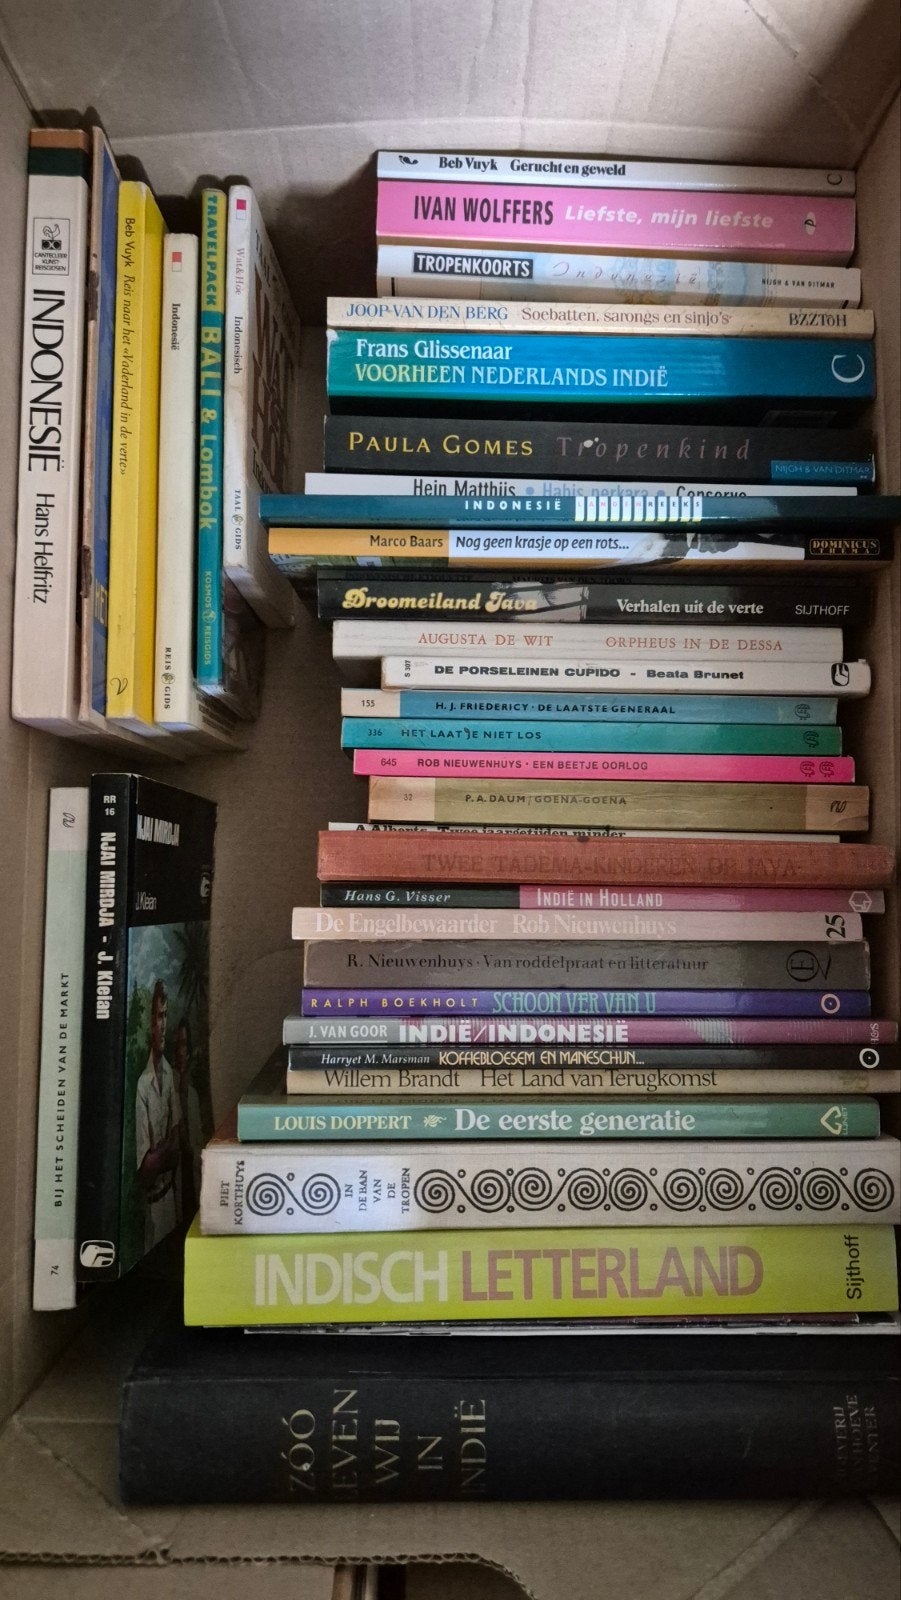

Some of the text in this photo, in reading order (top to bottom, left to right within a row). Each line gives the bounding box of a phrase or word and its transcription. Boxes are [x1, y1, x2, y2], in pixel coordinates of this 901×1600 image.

[439, 157, 626, 177] Beb Vuyk geweld
[414, 195, 774, 228] IVAN WOLFFERS Liefste, mijn liefste
[416, 254, 530, 277] TROPENKOORTS
[346, 303, 681, 325] JOOP VAN DEN BERG Soebatten, sarongs en
[120, 217, 136, 439] Beb Vuyk Reis naar het in de
[171, 303, 181, 351] Indonesië
[233, 316, 244, 374] Indonesisch
[356, 339, 513, 360] Frans Glissenaar
[200, 195, 222, 531] TRAVELPACK BALI Lombok
[355, 363, 669, 387] VOORHEEN NEDERLANDS INDIË
[28, 288, 66, 604] INDONESIË Hans Helfritz
[349, 432, 534, 456] PAULA GOMES
[413, 478, 447, 496] Hein
[464, 498, 562, 510] INDONESIË
[370, 534, 593, 553] Marco Baars Nog geen krasje op een
[812, 540, 877, 548] DOMINICUS
[204, 570, 212, 609] KOSMOS
[342, 586, 538, 613] Droomeiland Java
[616, 598, 764, 614] Verhalen uit de verte
[794, 604, 850, 615] SIJTHOFF
[418, 633, 783, 651] AUGUSTA DE WIT ORPHEUS IN DE DESSA
[164, 647, 172, 671] REIS
[434, 665, 744, 679] DE PORSELEINEN CUPIDO Beata Brunet
[361, 699, 676, 714] 155 H. J. FRIEDERICY DE LAATSTE GENERAAL
[367, 728, 542, 740] 336 HET NIET LOS
[380, 758, 648, 770] 645 ROB NIEUWENHUYS EEN BEETJE OORLOG
[103, 795, 117, 804] RR
[465, 795, 475, 803] P.
[105, 808, 115, 816] 16
[344, 890, 451, 903] Hans G. Visser
[537, 887, 663, 907] INDIË HOLLAND
[96, 832, 117, 1020] NJAI MIRDJA J. Kleian
[315, 912, 677, 939] De Engelbewaarder Rob Nieuwenhuys
[825, 914, 846, 939] 25
[347, 953, 709, 972] R. Nieuwenhuys Van en litteratuur
[311, 991, 656, 1014] RALPH BOEKHOLT SCHOON VAN U
[309, 1025, 388, 1038] J. VAN GOOR
[321, 1051, 556, 1068] Harryet M. Marsman EN
[54, 973, 69, 1207] BIJ HET SCHEIDEN VAN DE MARKT
[325, 1069, 718, 1092] Willem Brandt Het Land van Terugkomst
[274, 1108, 696, 1135] LOUIS DOPPERT De eerste generatie
[220, 1180, 230, 1207] PIET
[234, 1160, 245, 1225] KORTHUYS
[345, 1183, 353, 1198] IN
[373, 1179, 382, 1204] VAN
[387, 1182, 396, 1199] DE
[401, 1167, 411, 1214] TROPEN
[50, 1264, 59, 1276] 74
[255, 1245, 764, 1305] INDISCH LETTERLAND
[844, 1234, 862, 1300] Sijthoff
[417, 1435, 443, 1470] IN
